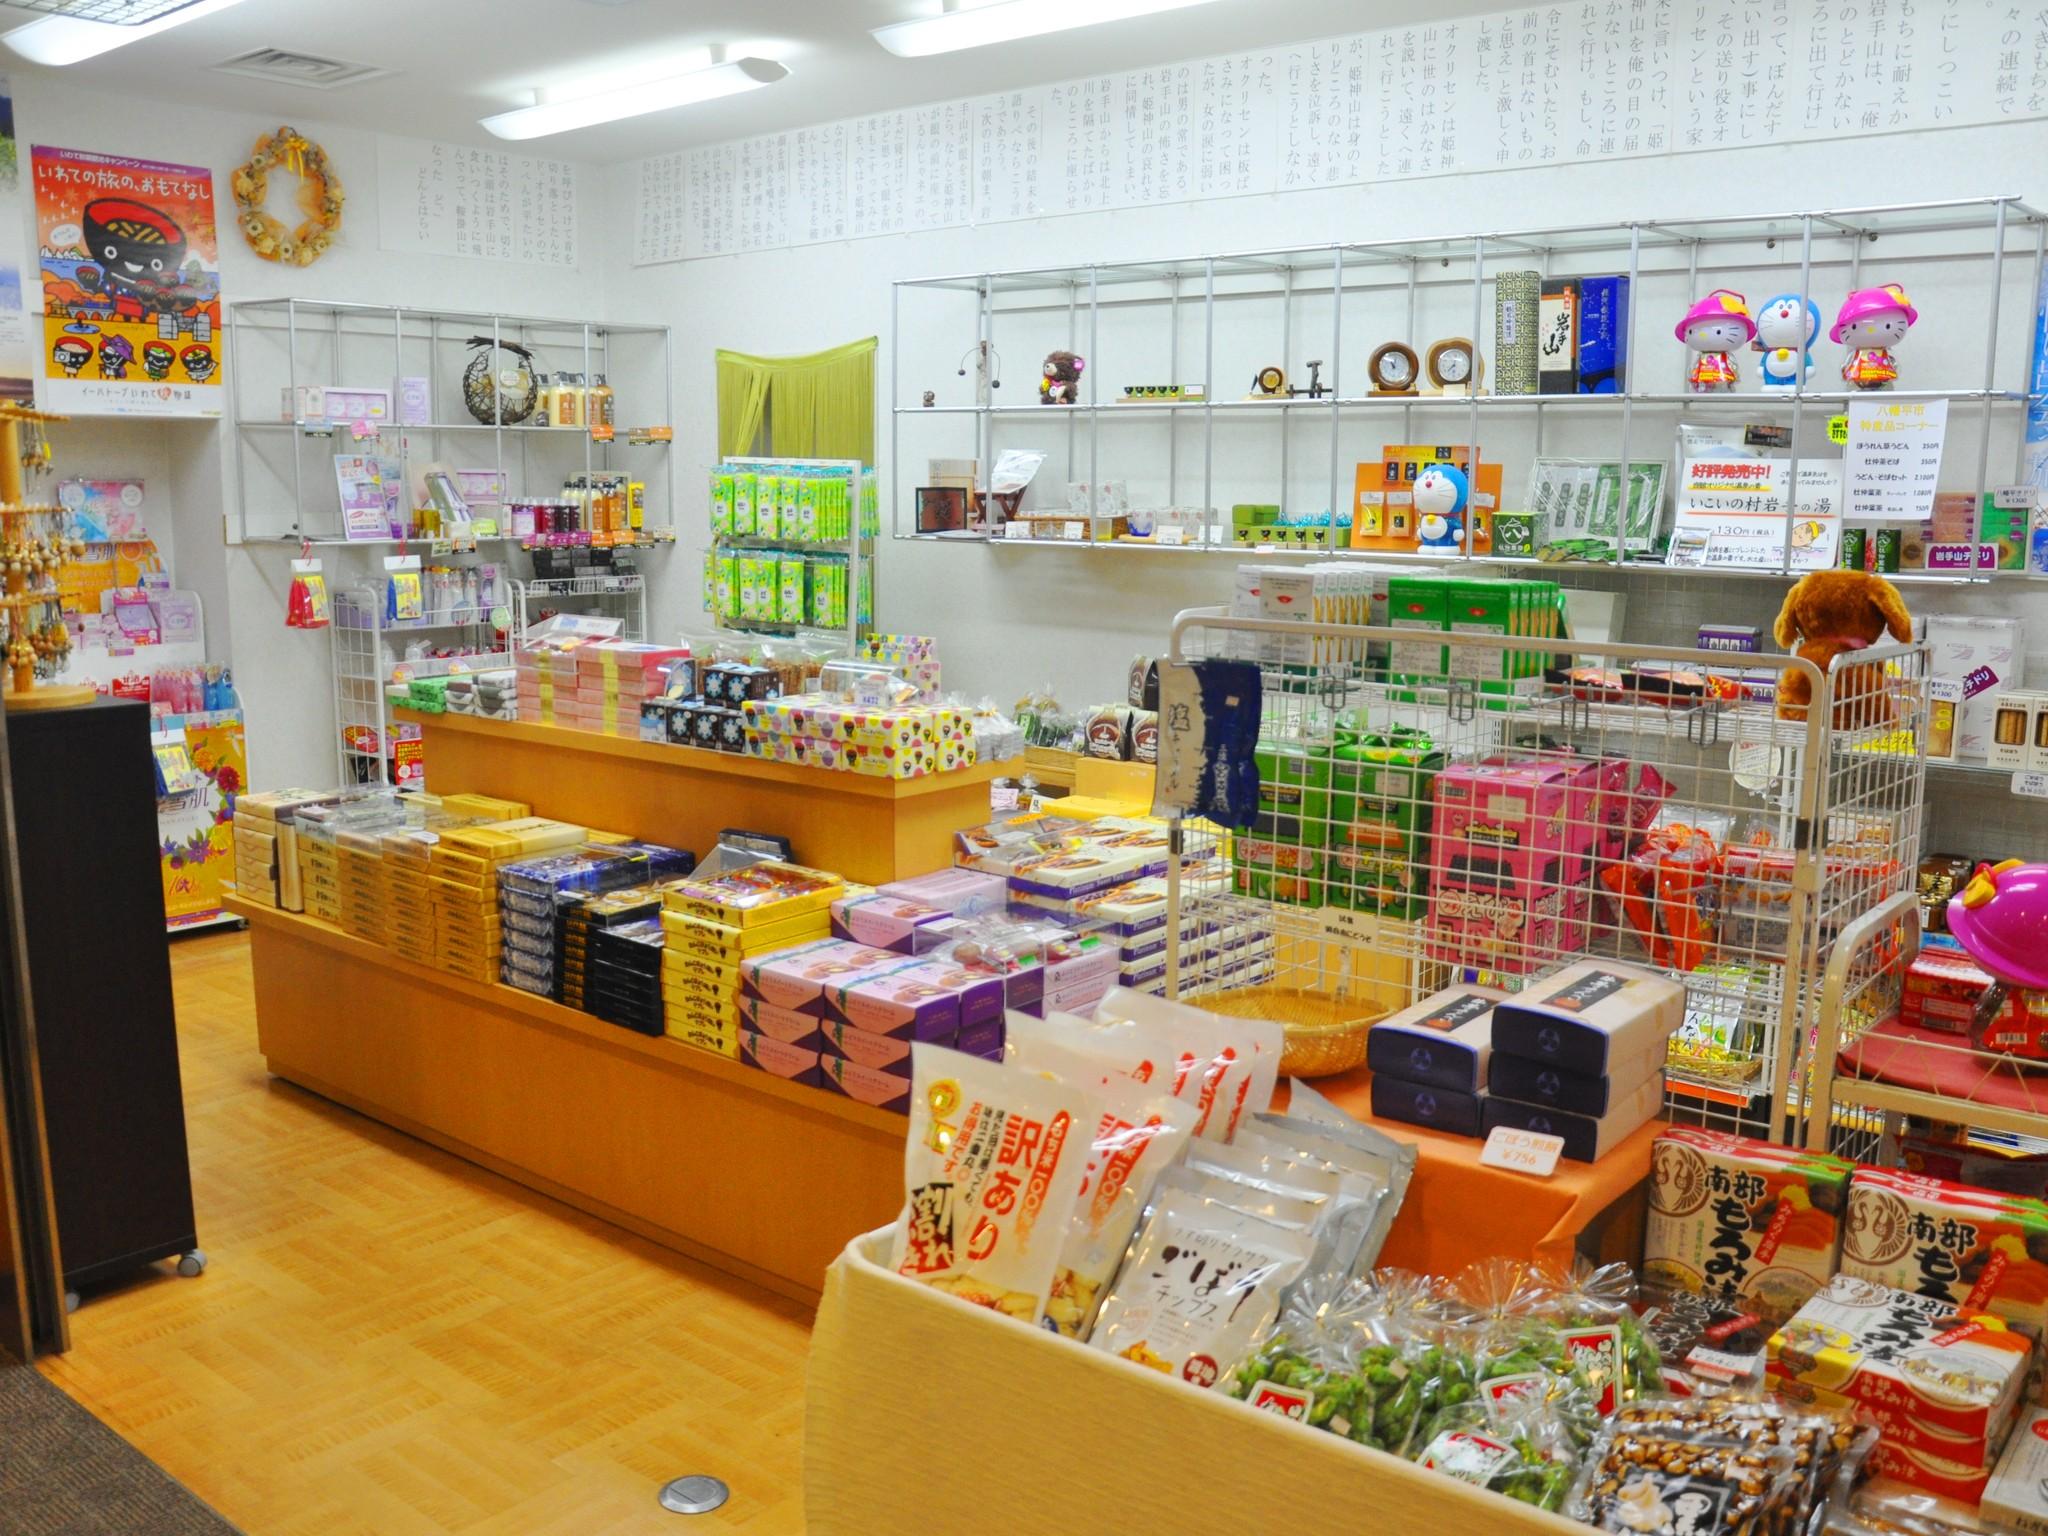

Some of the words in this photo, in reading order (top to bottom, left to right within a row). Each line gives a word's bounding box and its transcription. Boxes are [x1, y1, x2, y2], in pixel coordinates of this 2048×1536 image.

[1218, 57, 1234, 190] さみになって困っ
[1285, 52, 1302, 185] へ行こうとしなか
[1325, 42, 1343, 182] りどころのない悲
[1346, 37, 1363, 178] が、姫神山は身のよ
[1376, 33, 1396, 176] れて行こうとした
[1397, 30, 1416, 174] を説いて、遠くへ連
[1419, 26, 1438, 172] 山に世のはかなさ
[1439, 23, 1460, 169] オクリセンは姫神
[1475, 19, 1493, 94] し渡した。
[1496, 15, 1515, 165] と思え」と激しく申
[1517, 10, 1539, 161] 前の首はないもの
[1539, 7, 1562, 159] 令にそむいたら、お
[1575, 4, 1598, 156] れて行け。もし、命
[1686, 0, 1707, 145] リセンという家
[1803, 0, 1829, 129] ろに出て行け」
[1832, 0, 1858, 130] のとどかない
[38, 164, 210, 199] いわての旅の、おもてなし
[1098, 78, 1112, 207] 岩手山からは北上
[1542, 312, 1570, 356] 岩手山
[967, 1113, 1044, 1261] 訳あり
[1704, 1165, 1767, 1206] 南部
[1907, 1212, 1978, 1255] 南部
